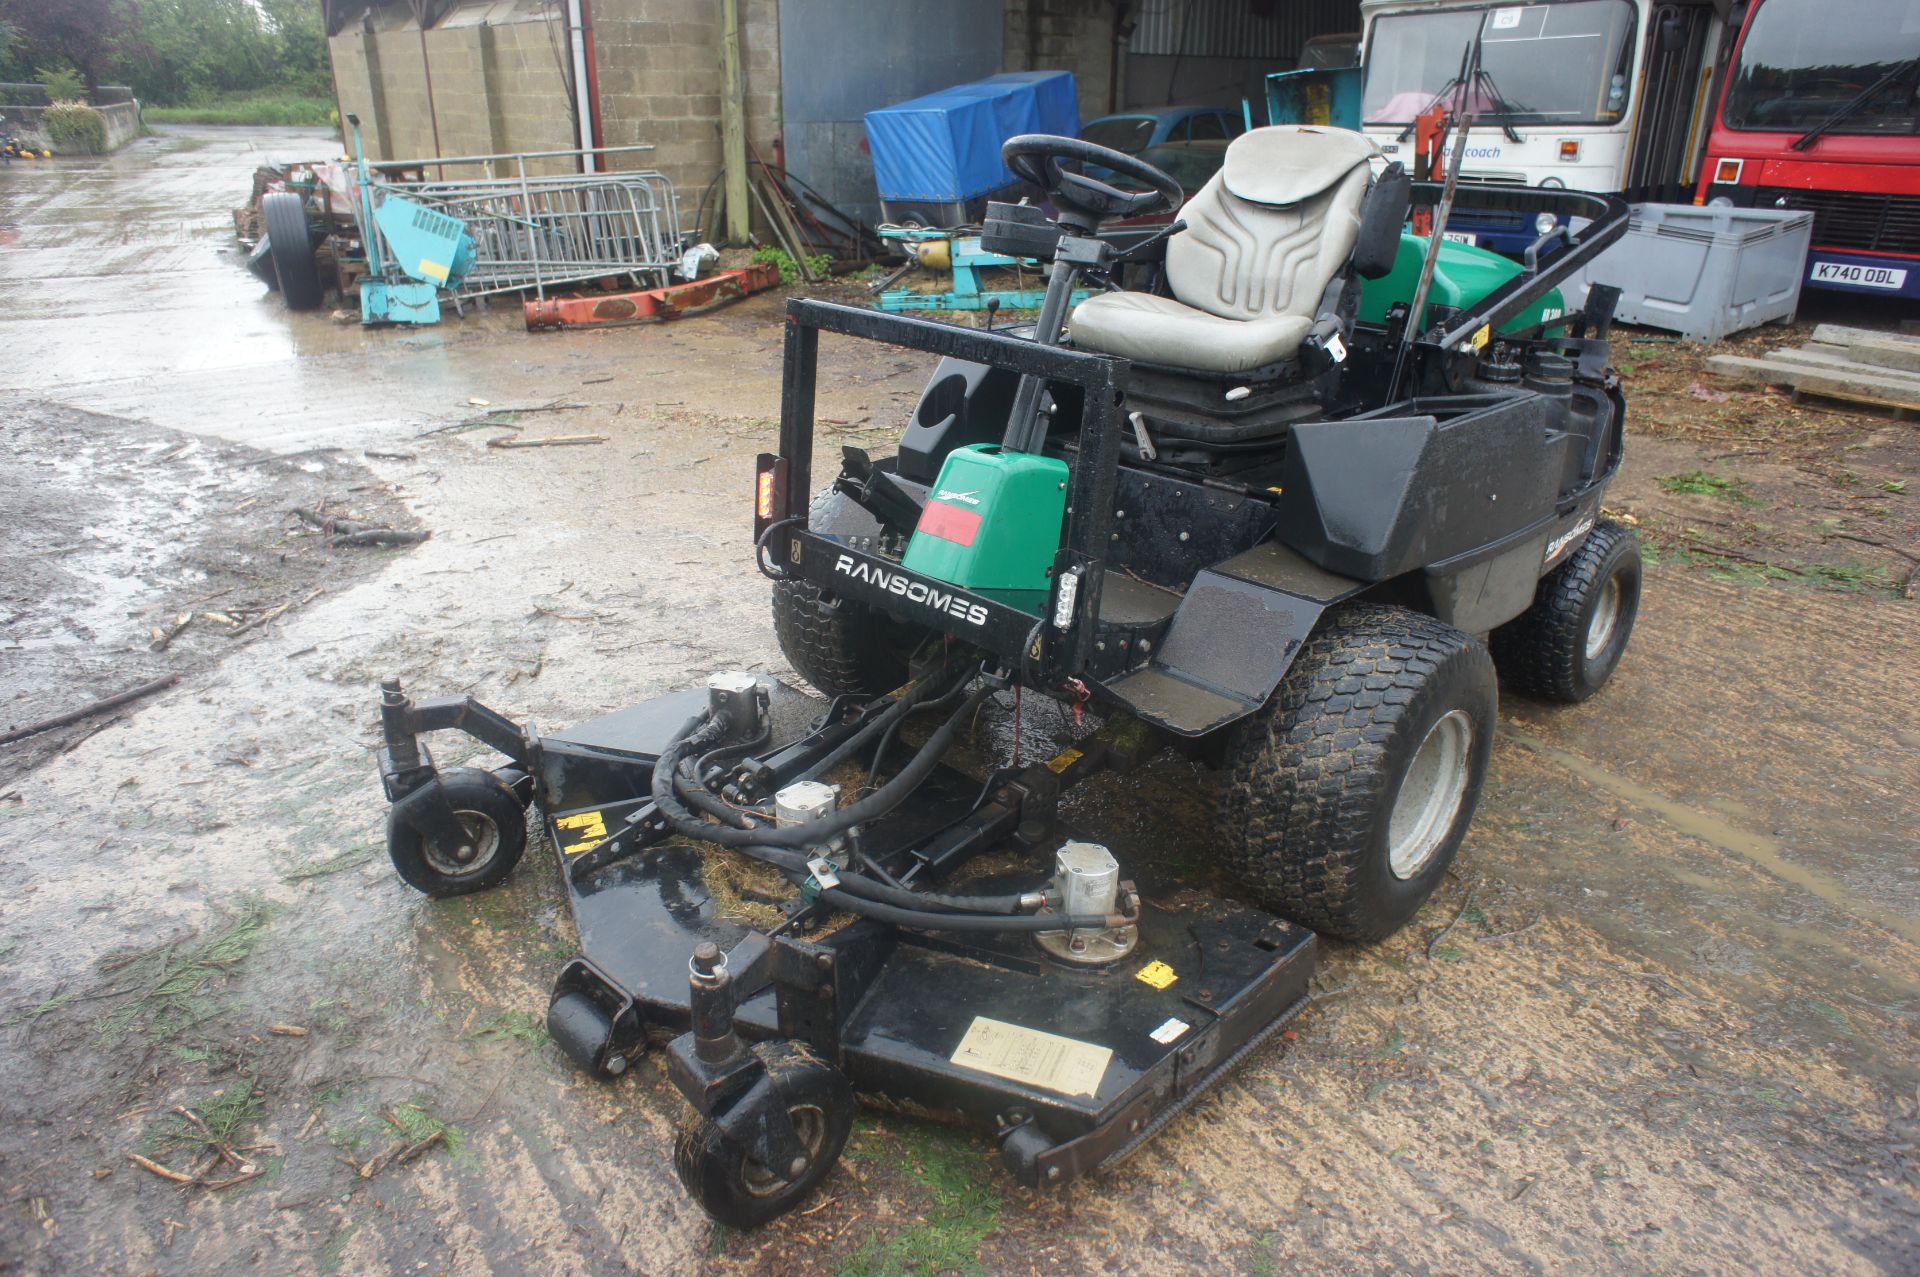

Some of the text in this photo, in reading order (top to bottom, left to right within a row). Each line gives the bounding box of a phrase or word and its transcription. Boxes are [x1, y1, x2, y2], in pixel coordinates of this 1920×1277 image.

[1443, 146, 1501, 159] acoach
[1818, 264, 1896, 284] K740 ODL
[834, 554, 989, 626] RANSOMES
